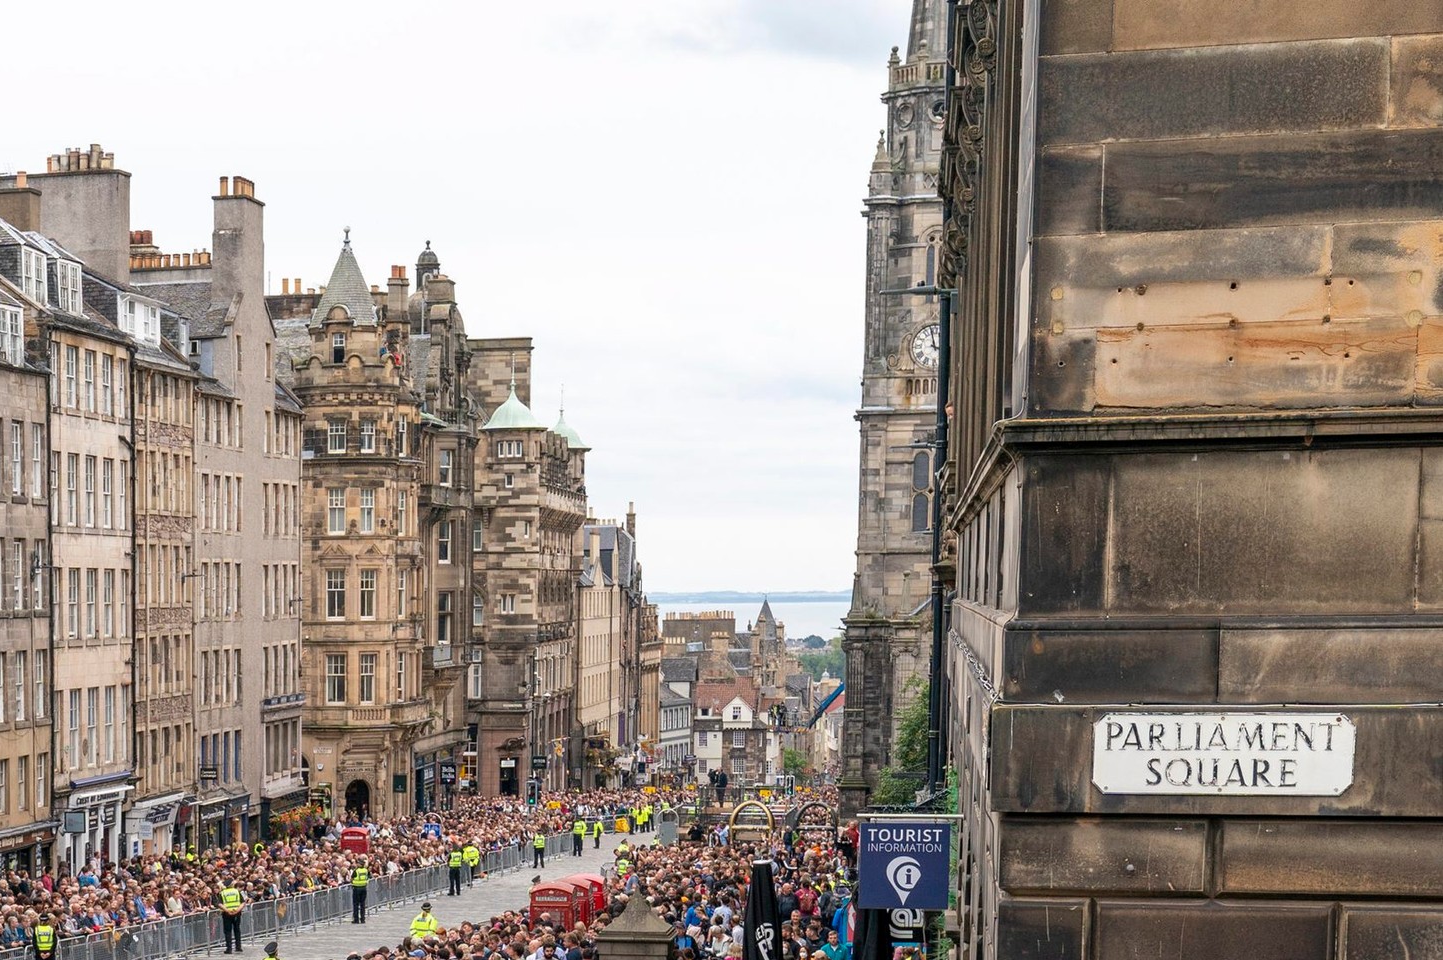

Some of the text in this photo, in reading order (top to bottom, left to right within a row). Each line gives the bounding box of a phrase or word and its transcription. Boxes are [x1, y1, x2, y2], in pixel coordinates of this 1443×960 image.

[1104, 722, 1342, 751] PARLIAMENT
[1145, 757, 1298, 788] SQUARE
[867, 829, 942, 842] TOURIST
[867, 843, 942, 852] INFORMATION
